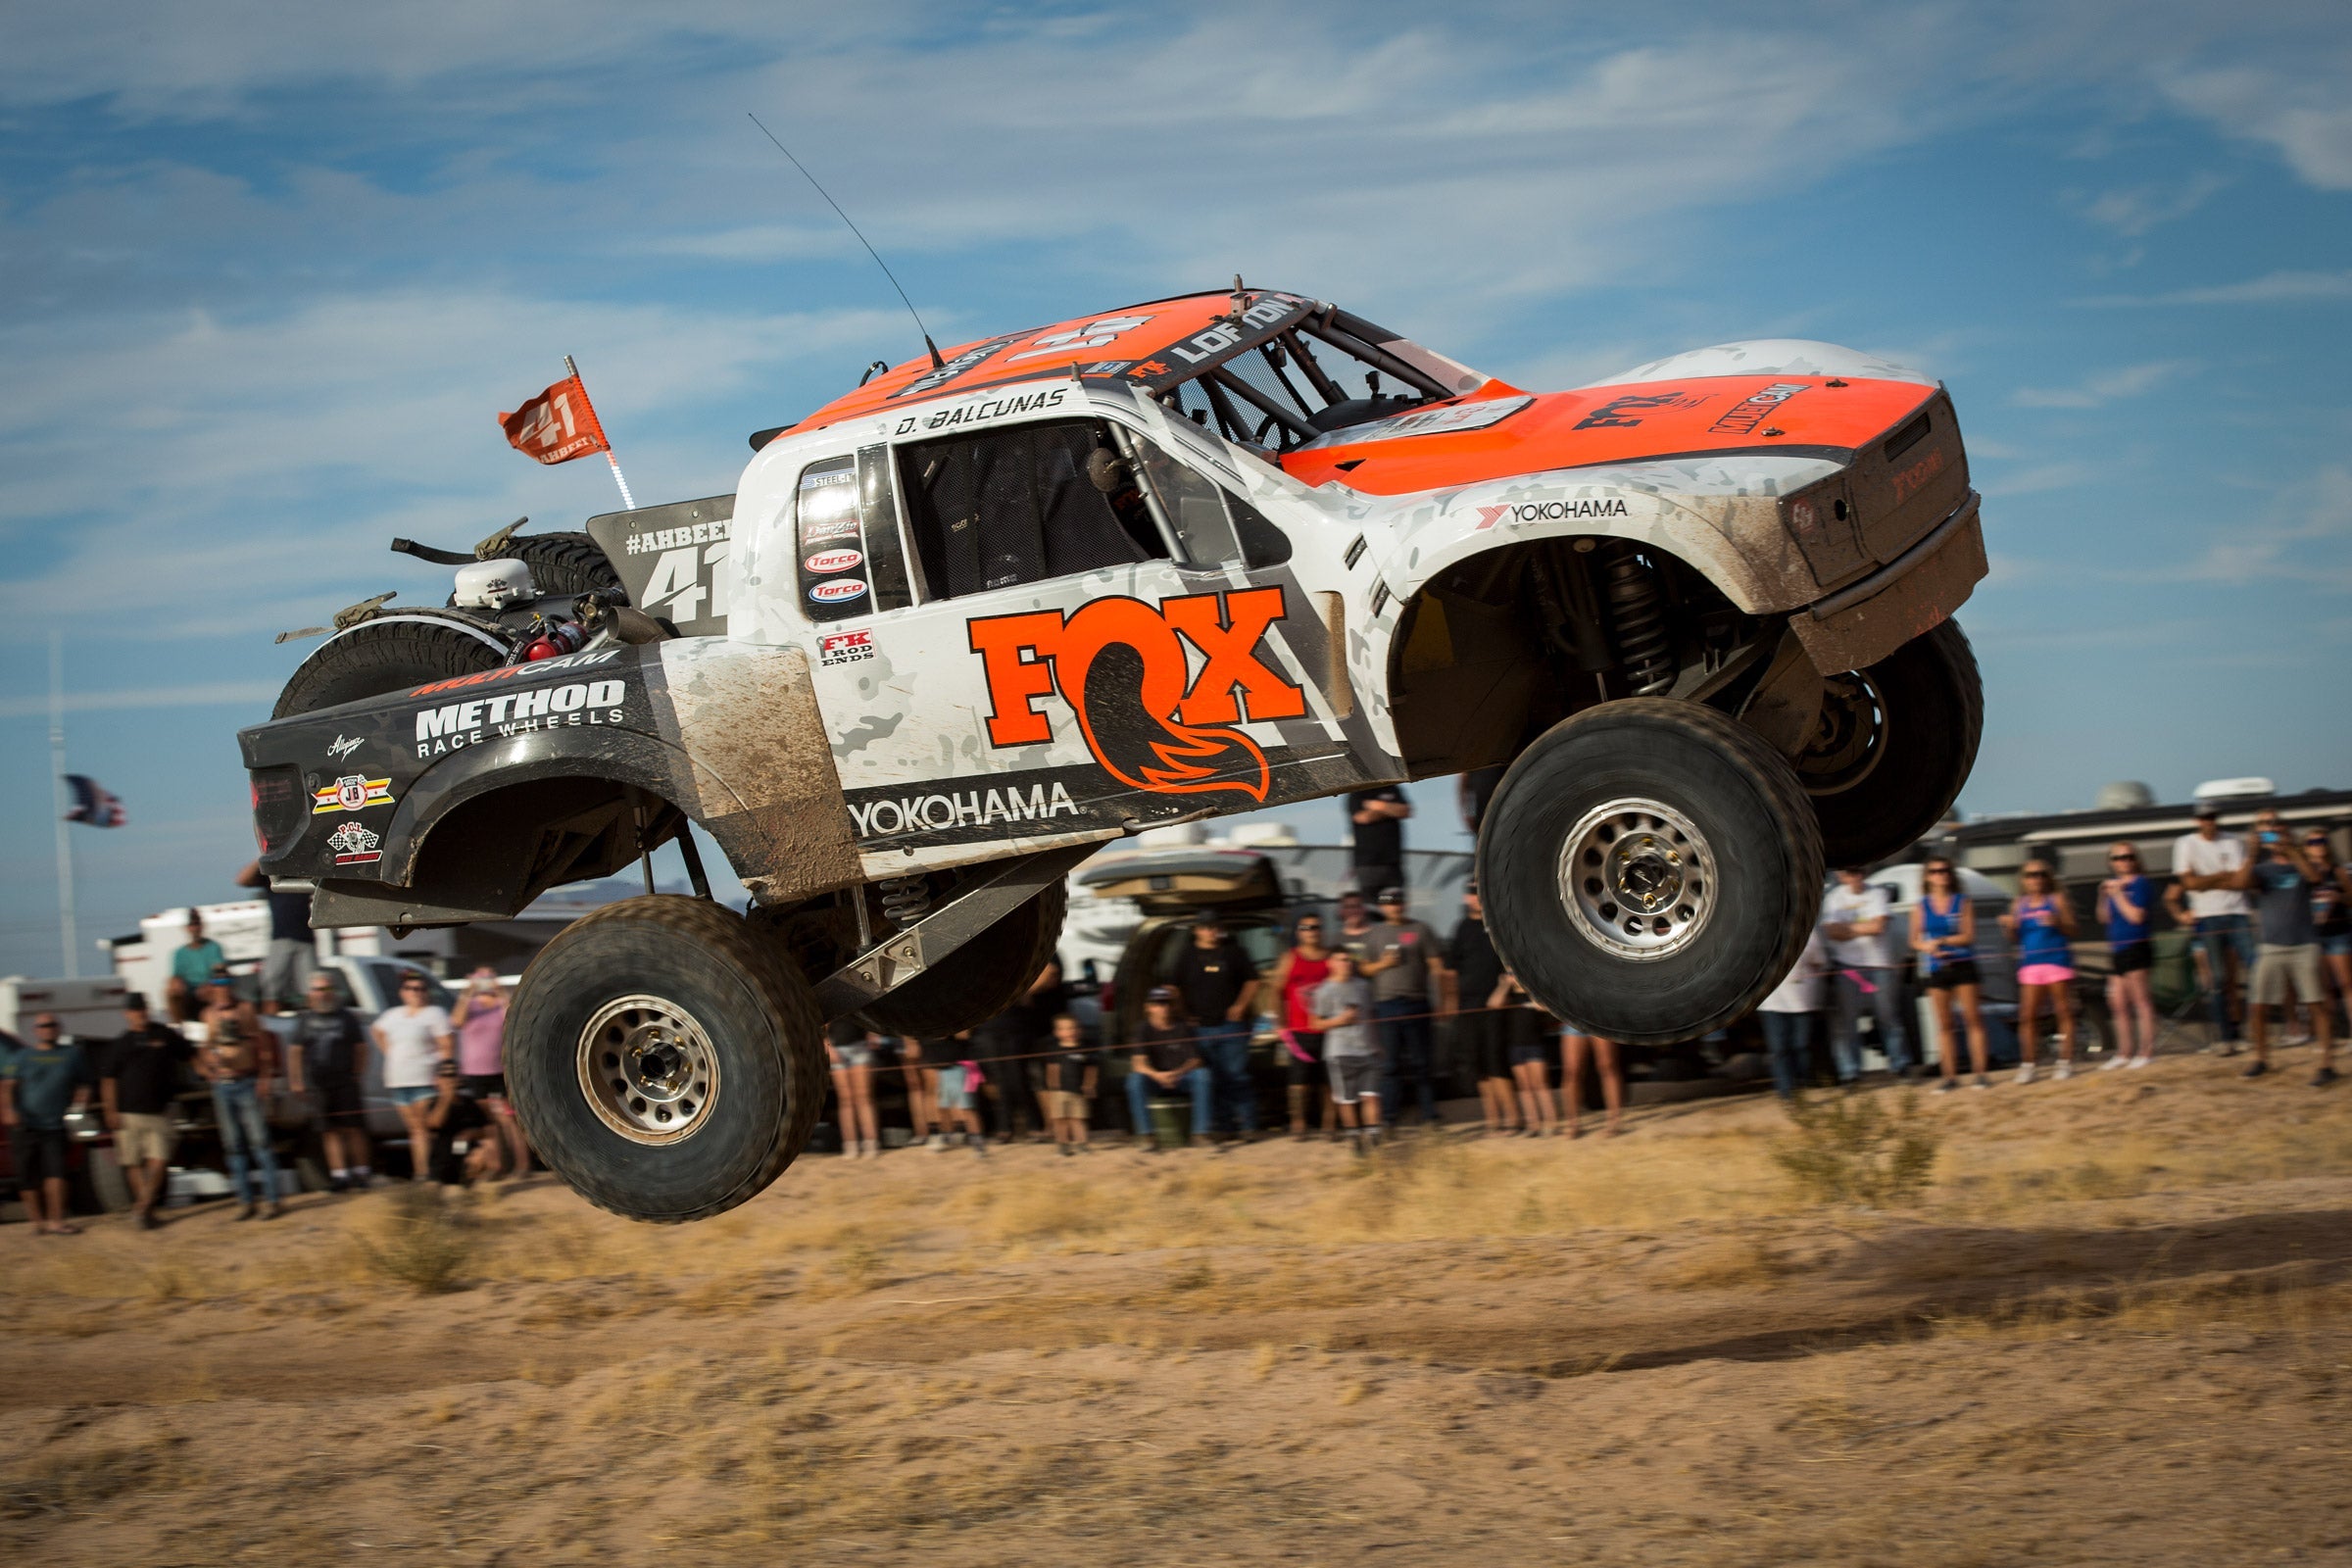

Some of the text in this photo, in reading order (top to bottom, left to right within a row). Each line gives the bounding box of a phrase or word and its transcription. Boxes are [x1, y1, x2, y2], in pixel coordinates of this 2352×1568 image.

[1171, 299, 1295, 364] LOFTON
[519, 392, 576, 449] 41
[895, 388, 1068, 436] D. BALCUNAS
[815, 472, 856, 487] STEEL-IT
[1511, 499, 1628, 522] YOKOHAMA
[641, 540, 732, 624] 41
[821, 652, 874, 666] ENDS
[824, 631, 871, 652] FK
[832, 645, 873, 657] ROD
[409, 649, 621, 698] MULTICAM
[966, 585, 1308, 803] FOX
[416, 679, 625, 742] METHOD
[416, 709, 624, 760] RACE WHEELS
[847, 780, 1079, 838] YOKOHAMA
